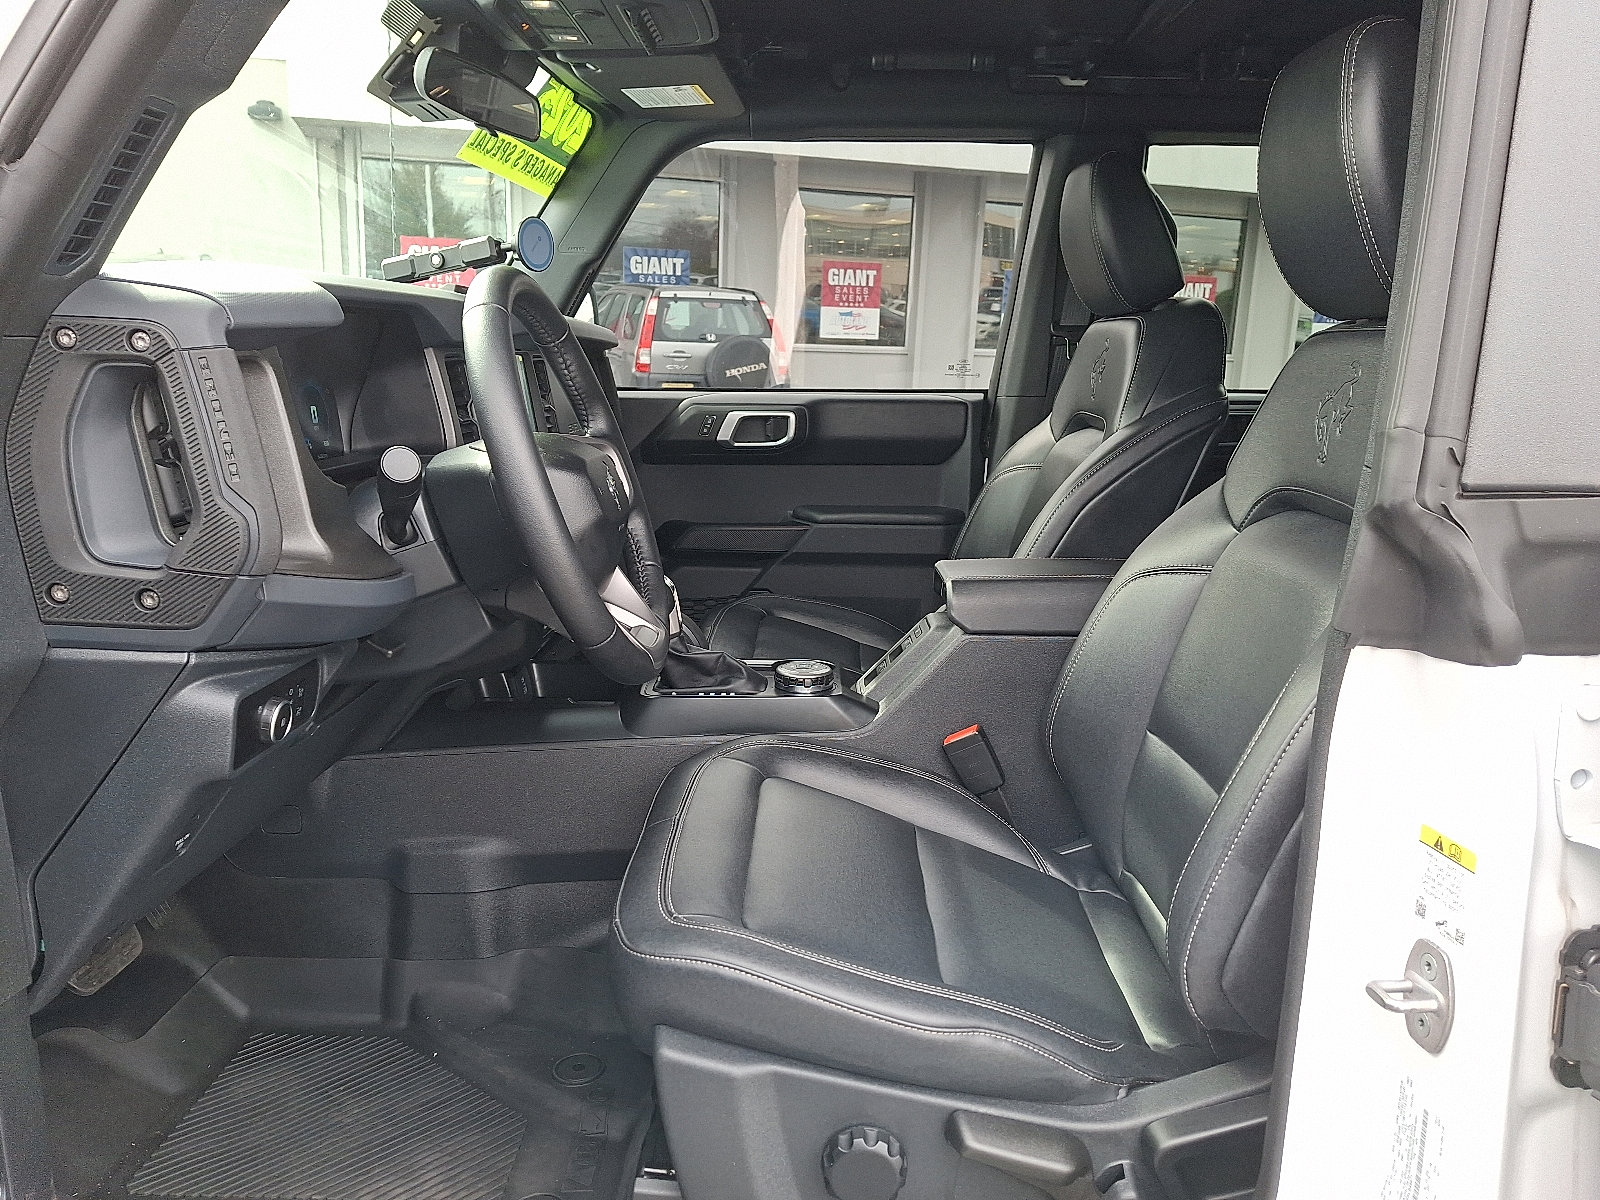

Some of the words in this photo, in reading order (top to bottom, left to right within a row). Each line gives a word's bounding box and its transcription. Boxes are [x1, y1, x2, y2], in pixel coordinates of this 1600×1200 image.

[630, 255, 685, 276] GIANT
[638, 274, 677, 284] SALES
[828, 268, 877, 287] GIANT
[834, 294, 869, 302] EVENT
[835, 286, 869, 295] SALES
[725, 362, 768, 378] HONDA
[198, 356, 240, 482] BRONCO
